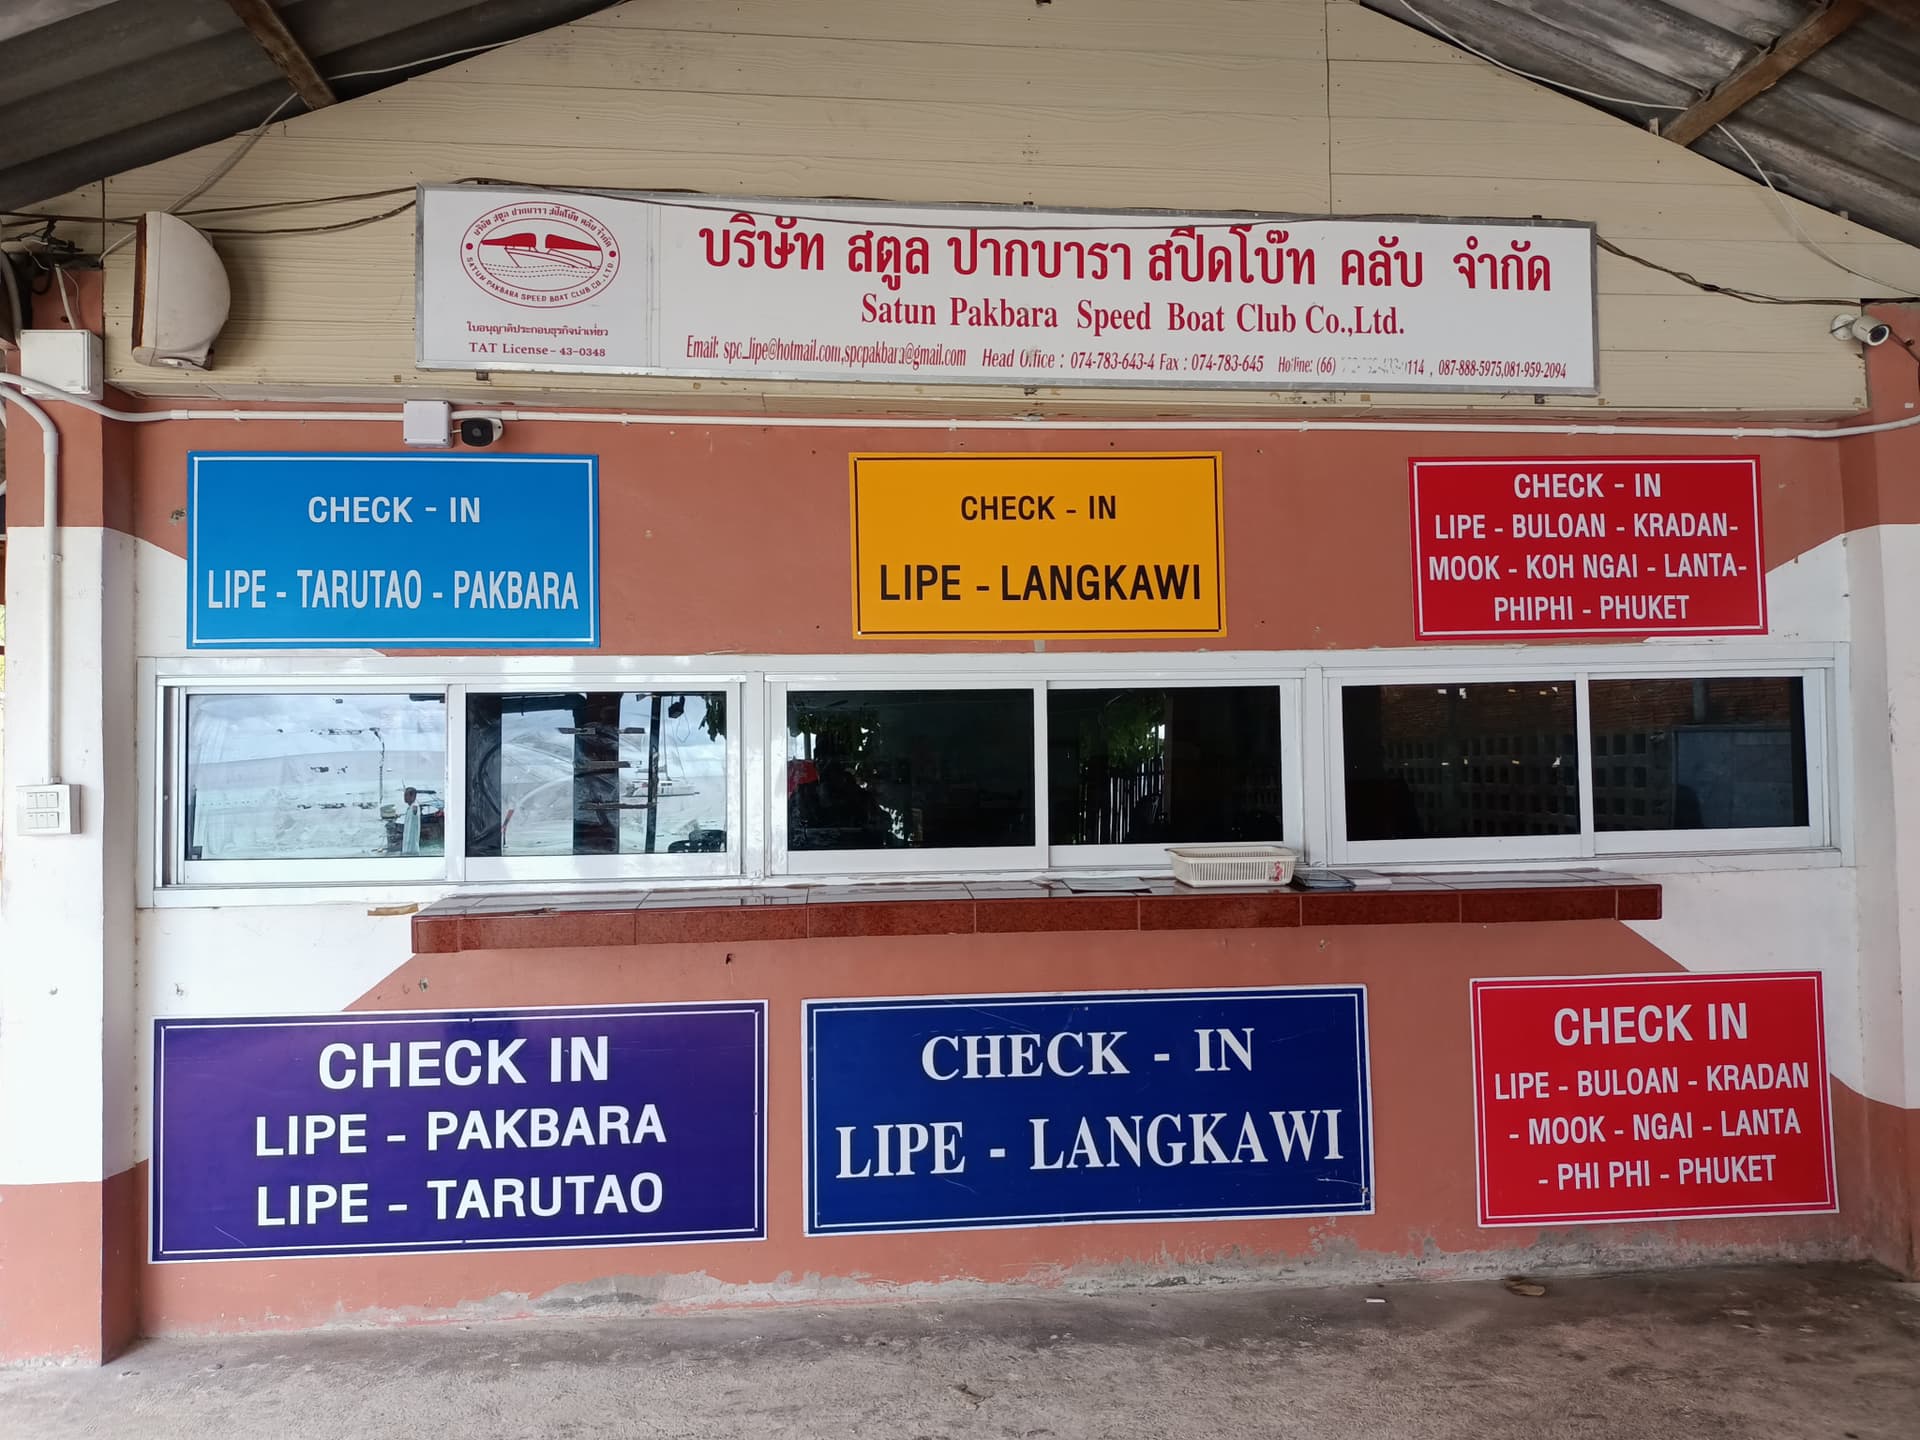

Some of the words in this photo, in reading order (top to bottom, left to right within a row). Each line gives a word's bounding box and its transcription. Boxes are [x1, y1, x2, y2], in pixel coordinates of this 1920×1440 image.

[698, 212, 825, 272] บริษัท
[848, 229, 930, 291] สตูล
[947, 227, 1132, 282] ปากบารา
[1148, 224, 1316, 286] สปีดโบ๊ท
[1341, 236, 1423, 289] คลับ
[1453, 236, 1552, 292] จำกัด
[466, 256, 486, 281] SATUN
[486, 279, 519, 298] PAKBARA
[520, 293, 547, 302] SPEED
[549, 293, 569, 303] BOAT
[570, 286, 591, 298] CLUB
[861, 292, 937, 327] Satun
[950, 297, 1058, 329] Pakbara
[1077, 299, 1152, 338] Speed
[1167, 302, 1225, 333] Boat
[1236, 303, 1297, 333] Club
[1305, 305, 1405, 337] Co.,Ltd.
[469, 342, 497, 353] TAT
[686, 334, 719, 359] Email:
[981, 348, 1015, 368] Head
[1070, 351, 1155, 371] 074-783-643-4
[1159, 353, 1179, 371] Fax
[1191, 353, 1265, 373] 074-783-645
[1316, 356, 1337, 376] (66)
[1514, 473, 1604, 499] CHECK
[1635, 473, 1661, 497] IN
[309, 496, 413, 523] CHECK
[450, 497, 480, 523] IN
[962, 495, 1056, 521] CHECK
[1089, 495, 1116, 520] IN
[1435, 514, 1486, 539] LIPE
[1512, 513, 1606, 538] BULOAN
[881, 564, 961, 601] LIPE
[1002, 563, 1201, 601] LANGKAWI
[1429, 555, 1500, 581] MOOK
[1526, 554, 1574, 579] KOH
[1583, 553, 1638, 578] NGAI
[208, 570, 266, 609] LIPE
[297, 569, 422, 609] TARUTAO
[454, 571, 579, 609] PAKBARA
[1494, 596, 1573, 621] PHIPHI
[1600, 594, 1690, 620] PHUKET
[1554, 1004, 1693, 1046] CHECK
[1708, 1002, 1748, 1040] IN
[318, 1039, 528, 1090] CHECK
[550, 1035, 609, 1083] IN
[921, 1031, 1130, 1081] CHECK
[1194, 1027, 1256, 1072] IN
[1495, 1072, 1550, 1100] LIPE
[1577, 1066, 1679, 1098] BULOAN
[1706, 1062, 1809, 1092] KRADAN
[256, 1112, 367, 1157] LIPE
[427, 1103, 667, 1152] PAKBARA
[835, 1121, 967, 1179] LIPE
[1029, 1109, 1345, 1171] LANGKAWI
[1528, 1115, 1606, 1145] MOOK
[1633, 1112, 1693, 1141] NGAI
[1721, 1108, 1801, 1137] LANTA
[1557, 1162, 1600, 1190] PHI
[1609, 1160, 1650, 1188] PHI
[1679, 1154, 1776, 1185] PHUKET
[257, 1182, 369, 1227] LIPE
[426, 1172, 663, 1221] TARUTAO
